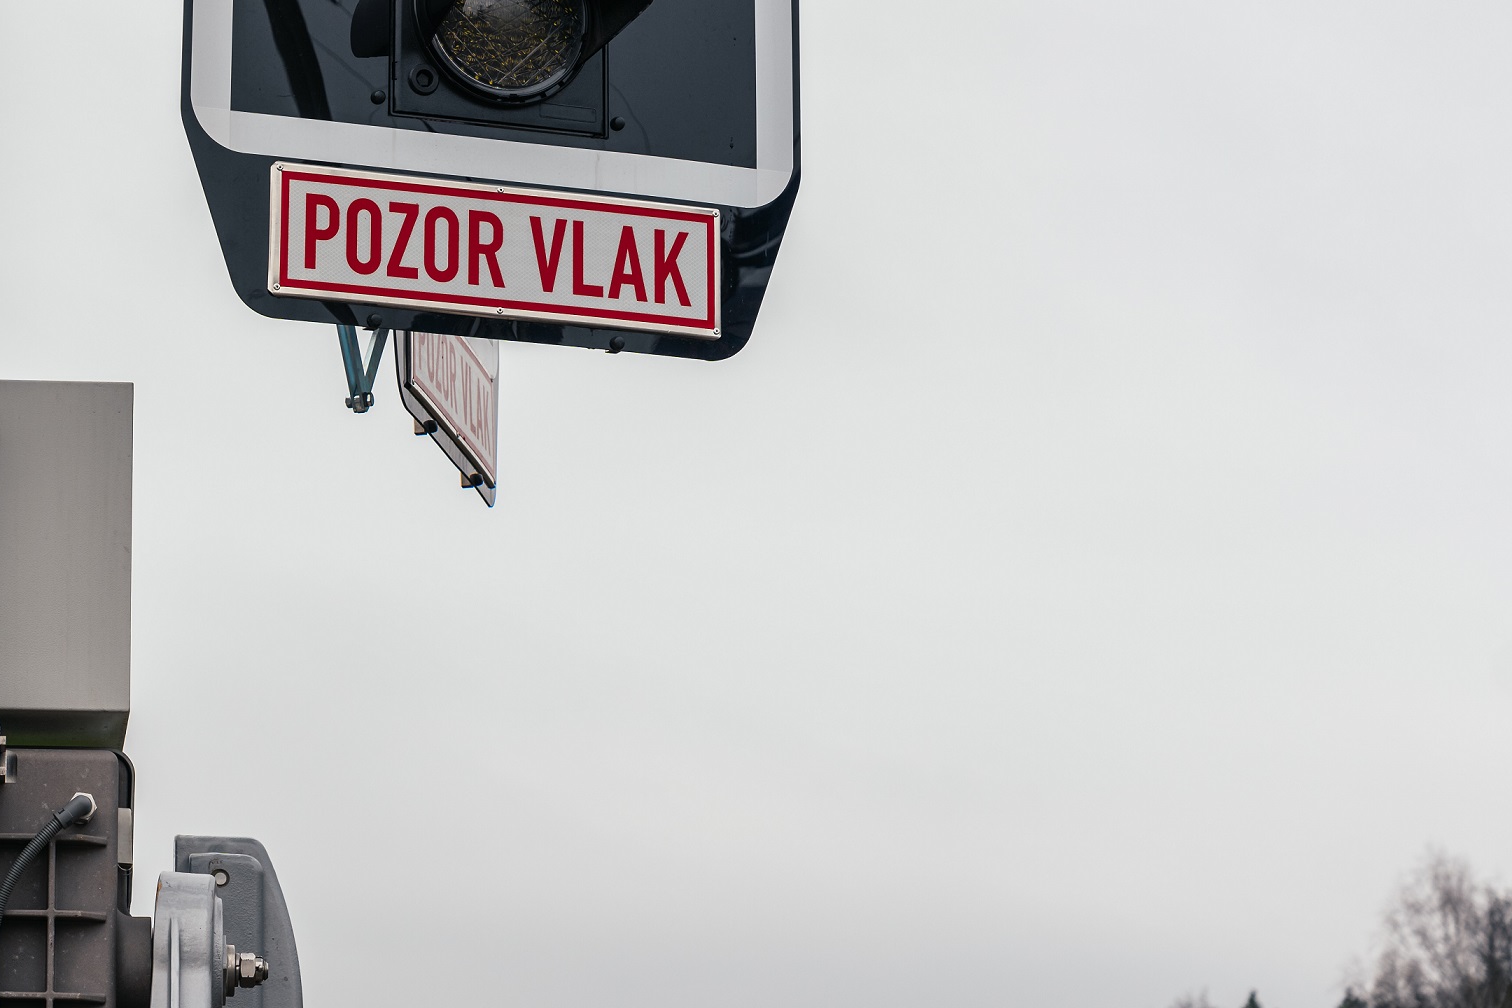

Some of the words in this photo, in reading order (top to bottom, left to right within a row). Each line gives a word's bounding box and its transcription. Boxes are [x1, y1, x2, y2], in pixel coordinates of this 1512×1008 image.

[304, 193, 505, 289] POZOR
[529, 215, 692, 307] VLAK
[460, 354, 492, 456] VLAK
